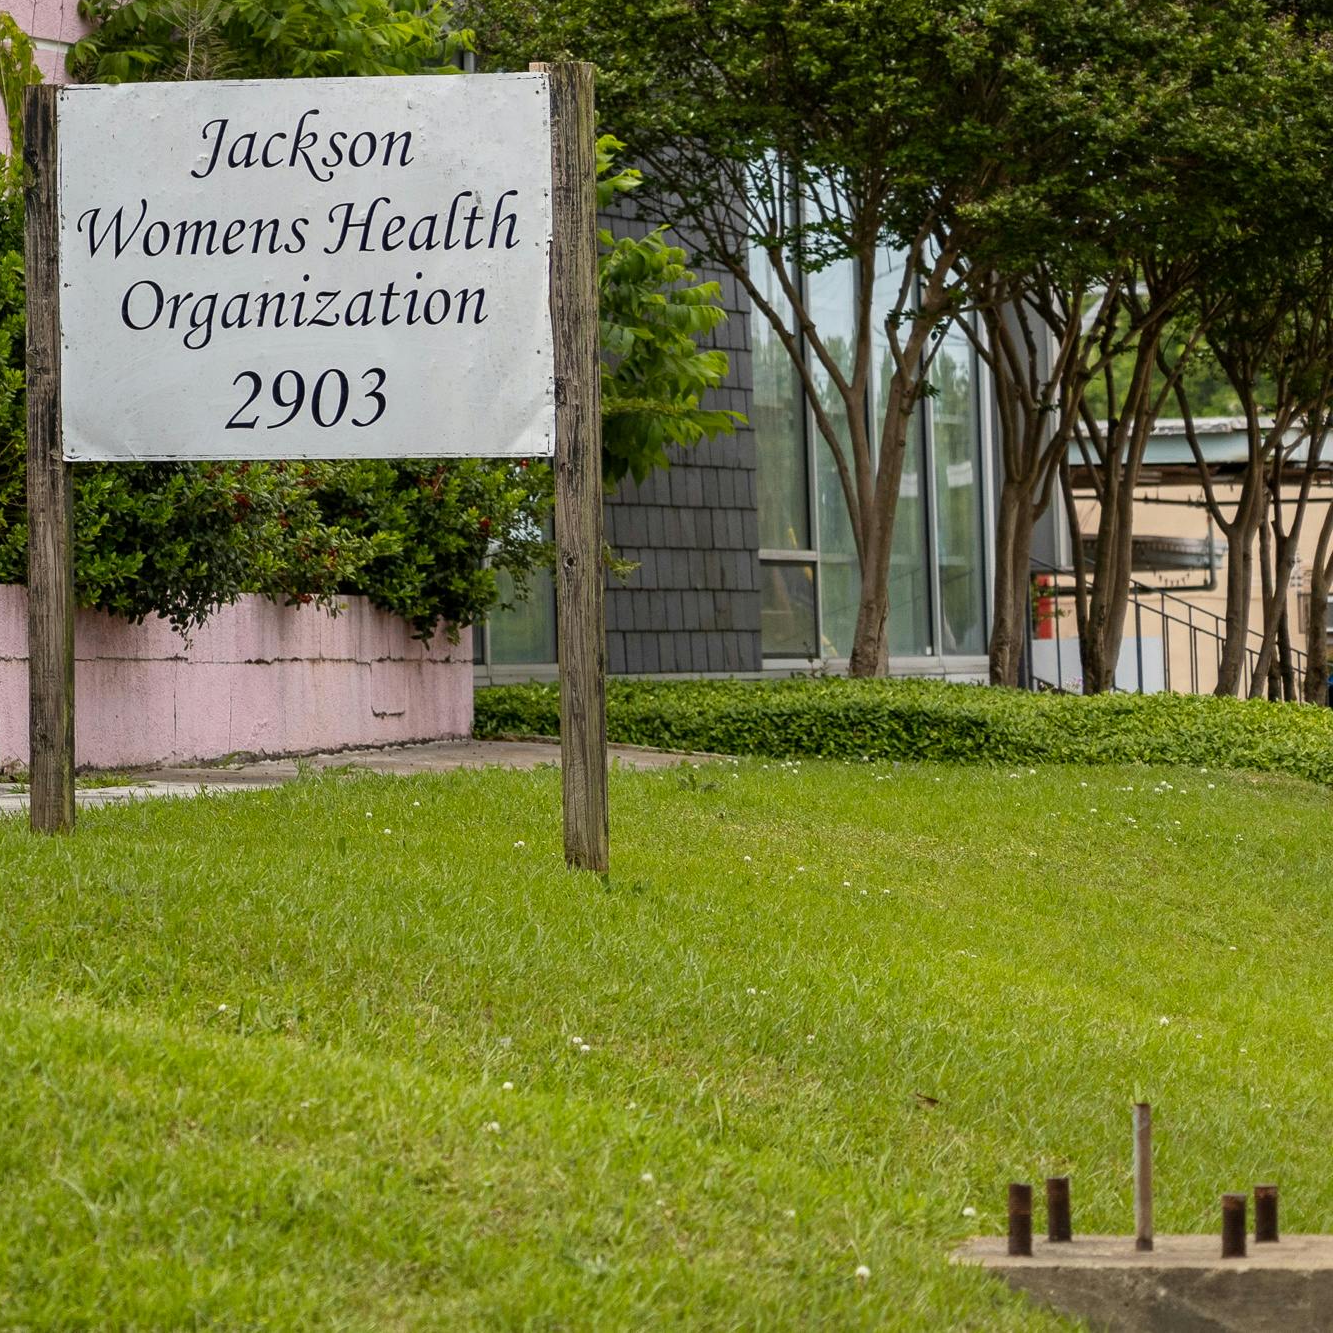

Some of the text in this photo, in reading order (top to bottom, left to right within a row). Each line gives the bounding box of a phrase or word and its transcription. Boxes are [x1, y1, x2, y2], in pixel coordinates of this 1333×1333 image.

[190, 108, 415, 183] Jackson
[77, 189, 521, 260] Womens Health
[120, 272, 489, 350] Organization
[224, 366, 388, 430] 2903
